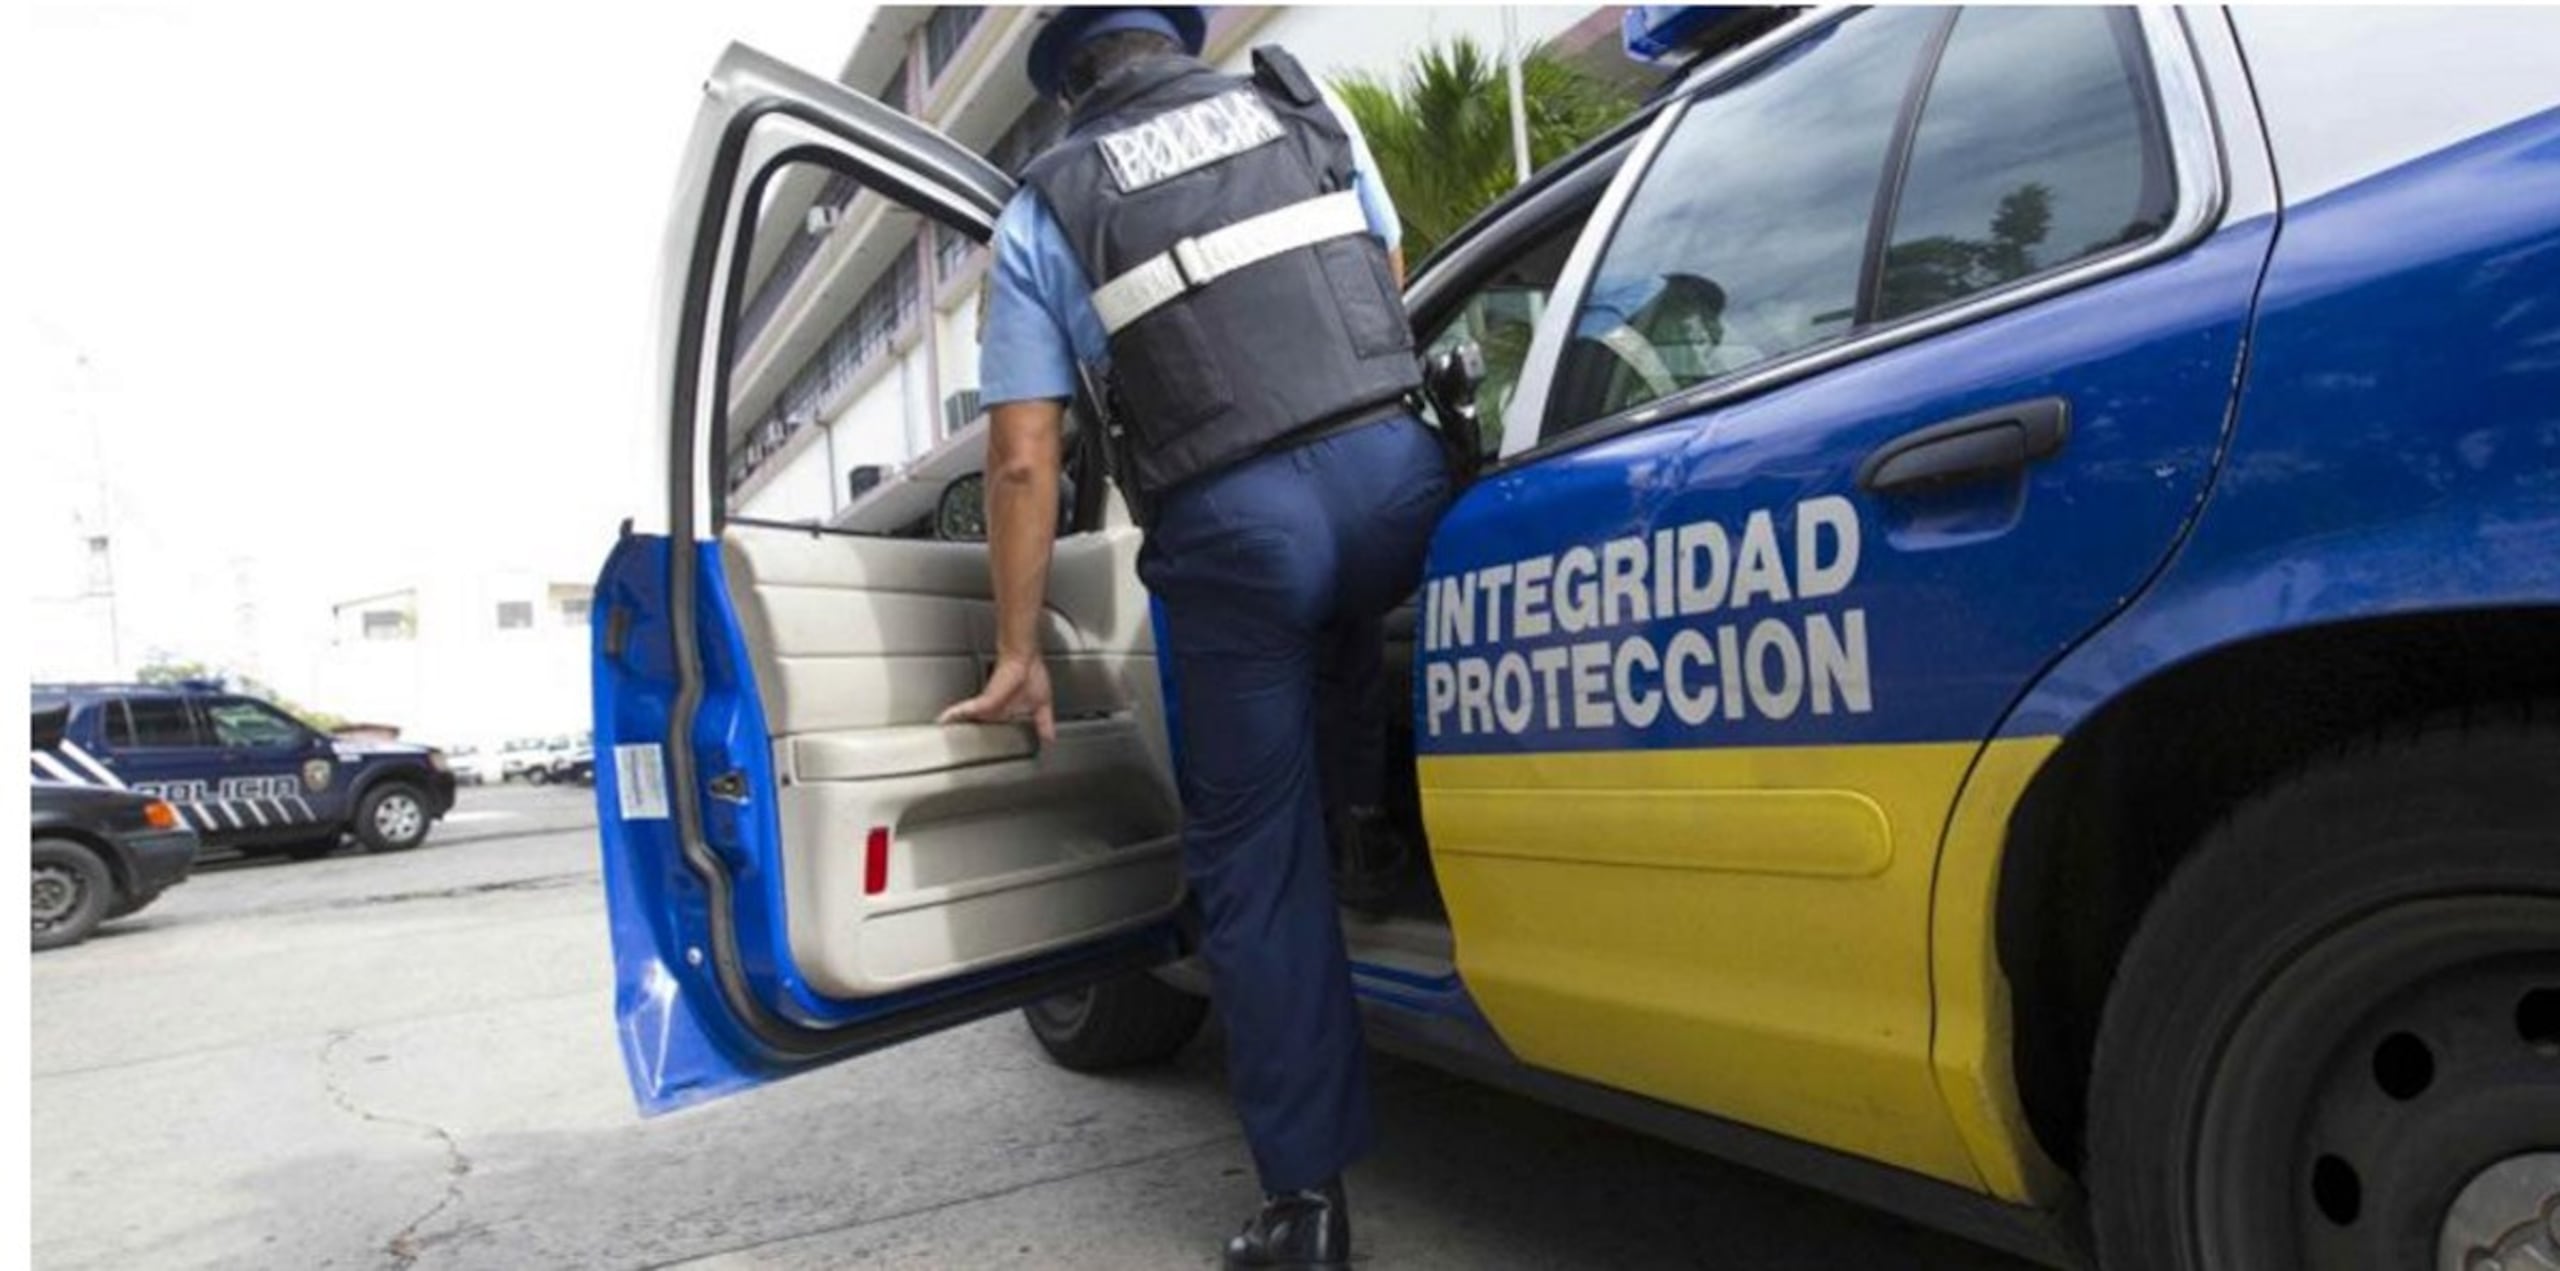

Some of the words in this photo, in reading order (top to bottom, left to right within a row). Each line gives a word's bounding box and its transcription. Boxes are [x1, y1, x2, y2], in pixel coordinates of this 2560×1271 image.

[1102, 88, 1280, 189] POLICIA
[1424, 495, 1860, 652] INTEGRIDAD
[1427, 609, 1873, 737] PROTECCION
